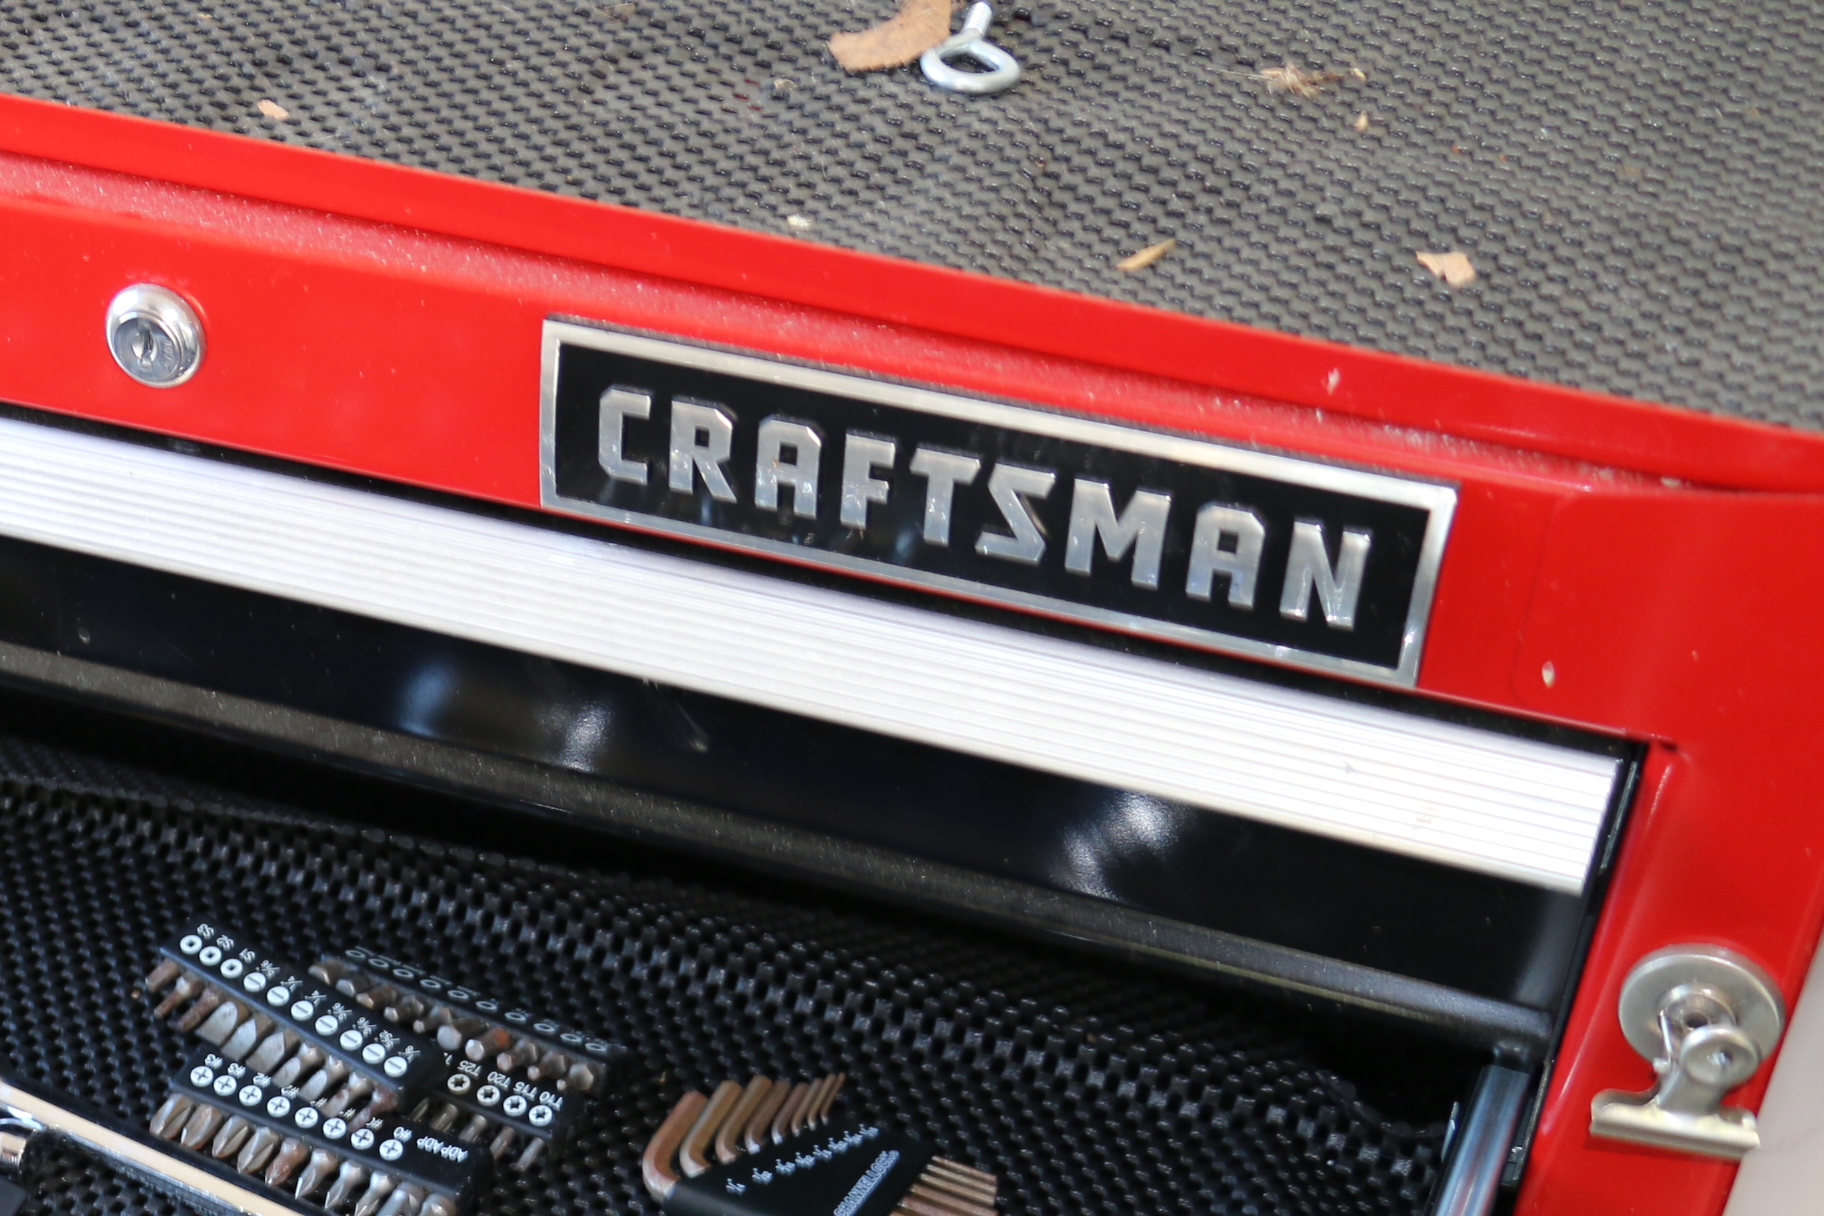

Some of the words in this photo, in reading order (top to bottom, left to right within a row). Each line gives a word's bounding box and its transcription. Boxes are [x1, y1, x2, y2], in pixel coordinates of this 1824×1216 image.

[596, 384, 1372, 632] CRAFTSMAN
[457, 1060, 481, 1078] T25
[487, 1071, 511, 1091] T20
[513, 1081, 537, 1101] T15
[539, 1091, 563, 1111] T10
